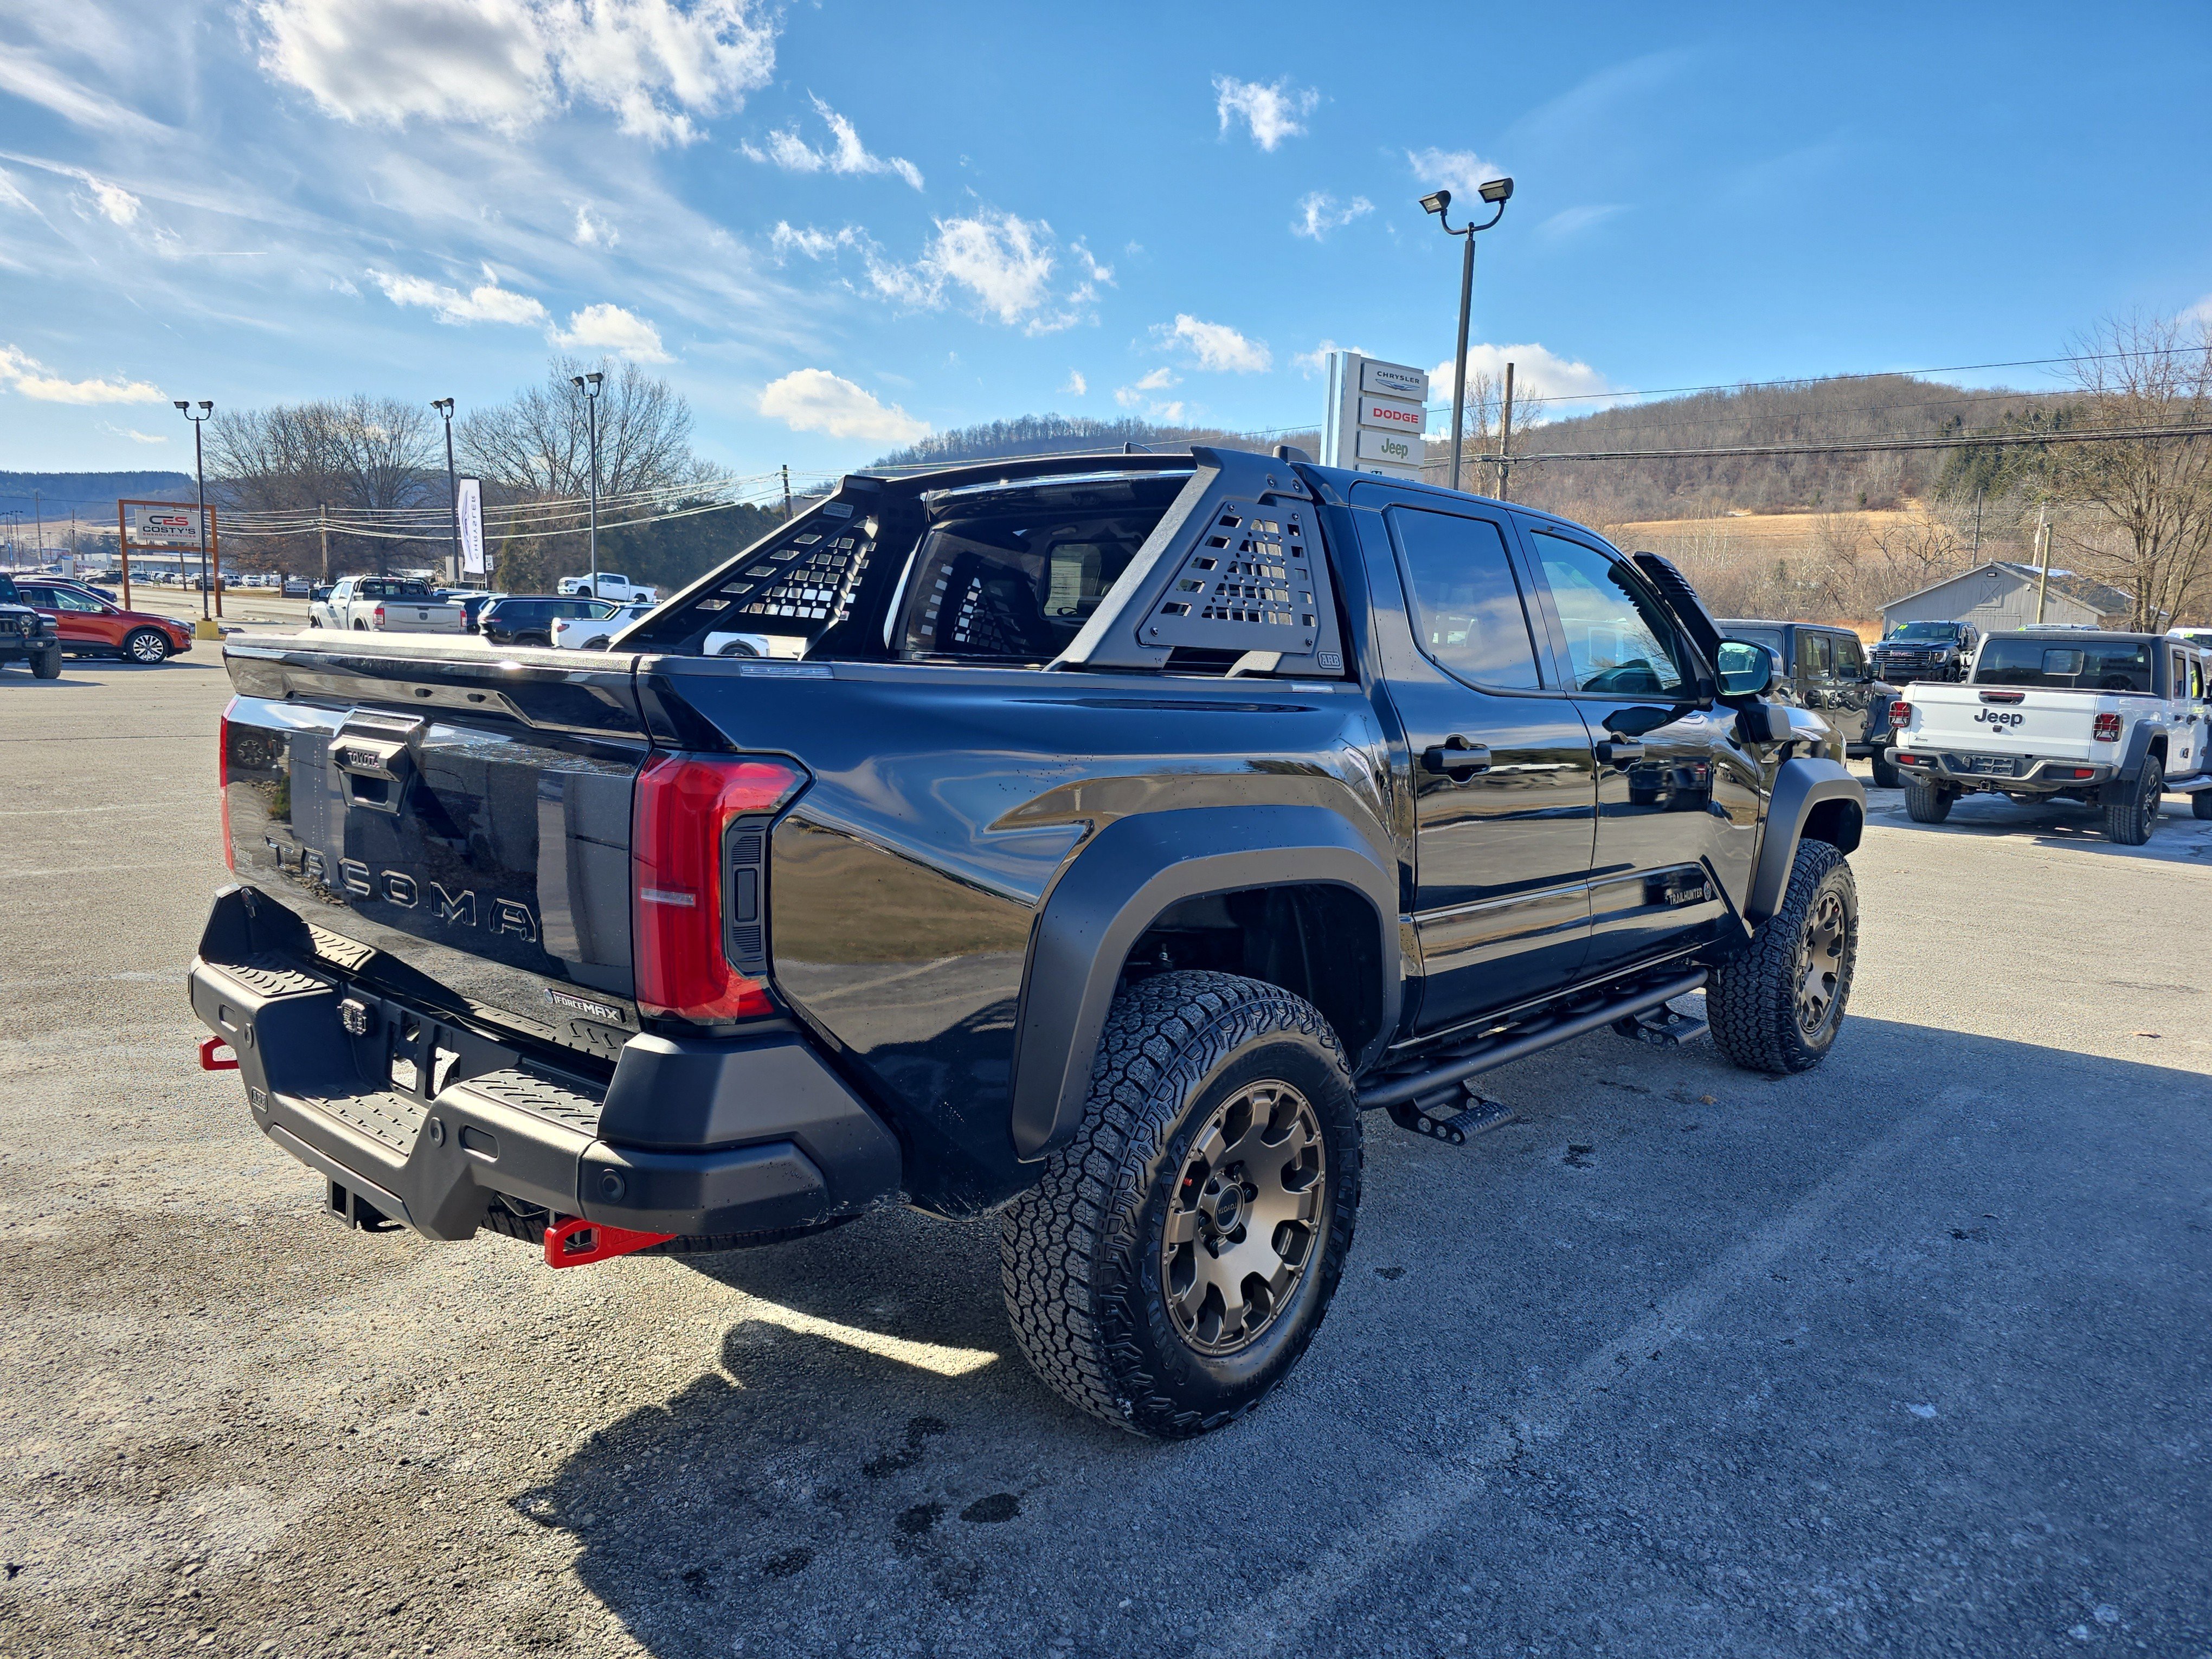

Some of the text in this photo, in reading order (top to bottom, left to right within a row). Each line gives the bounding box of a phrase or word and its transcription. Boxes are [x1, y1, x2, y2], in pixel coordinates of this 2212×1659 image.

[1377, 371, 1420, 384] CHRYSLER
[1373, 408, 1419, 423] DODGE
[1381, 438, 1409, 459] Jeep
[149, 516, 189, 526] CES
[143, 526, 196, 535] COSTY'S
[1321, 654, 1340, 666] ARB
[1974, 708, 2023, 727] Jeep
[347, 750, 380, 768] TOYOTA
[266, 835, 537, 943] TACOMA
[1669, 888, 1703, 905] TRAILHUNTER
[1218, 1202, 1237, 1214] TOYOTA
